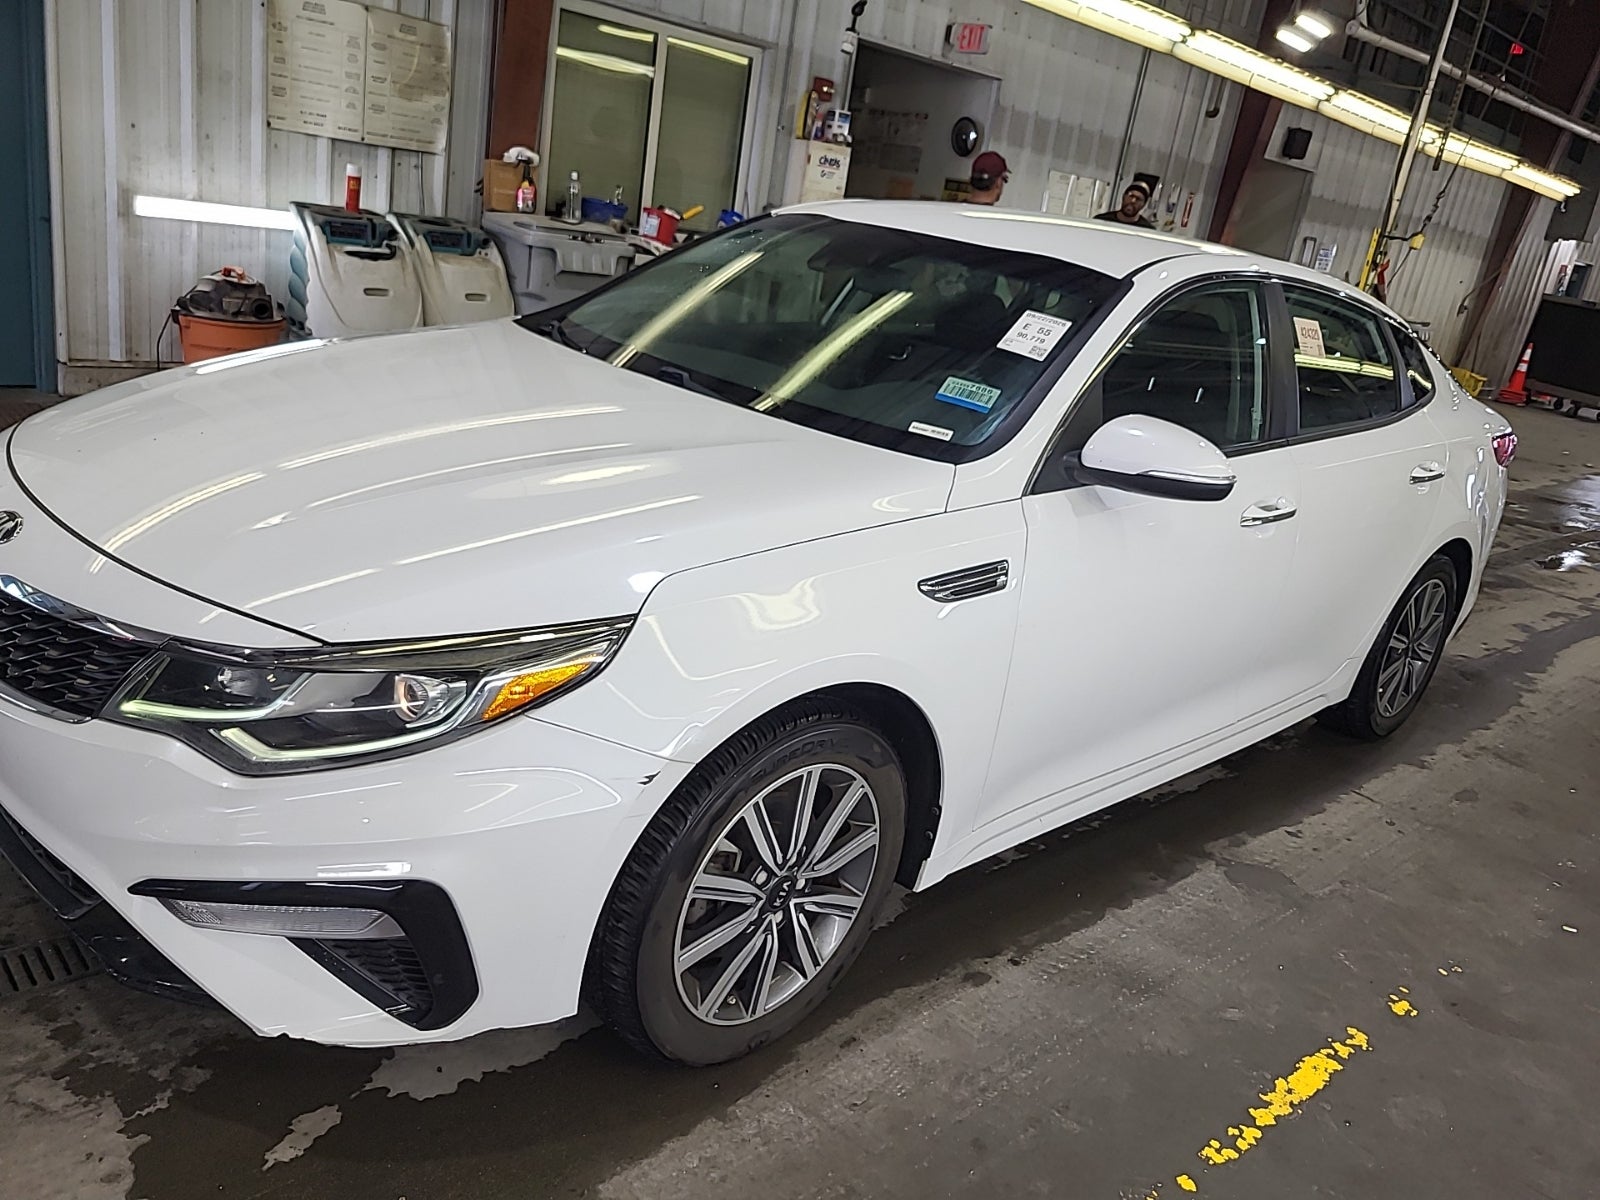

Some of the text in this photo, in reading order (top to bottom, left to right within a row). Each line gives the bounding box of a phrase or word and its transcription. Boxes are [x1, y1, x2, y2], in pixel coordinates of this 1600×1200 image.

[959, 24, 984, 51] EXIT
[1022, 323, 1032, 331] E
[1036, 327, 1052, 337] 55
[773, 881, 792, 906] KIA
